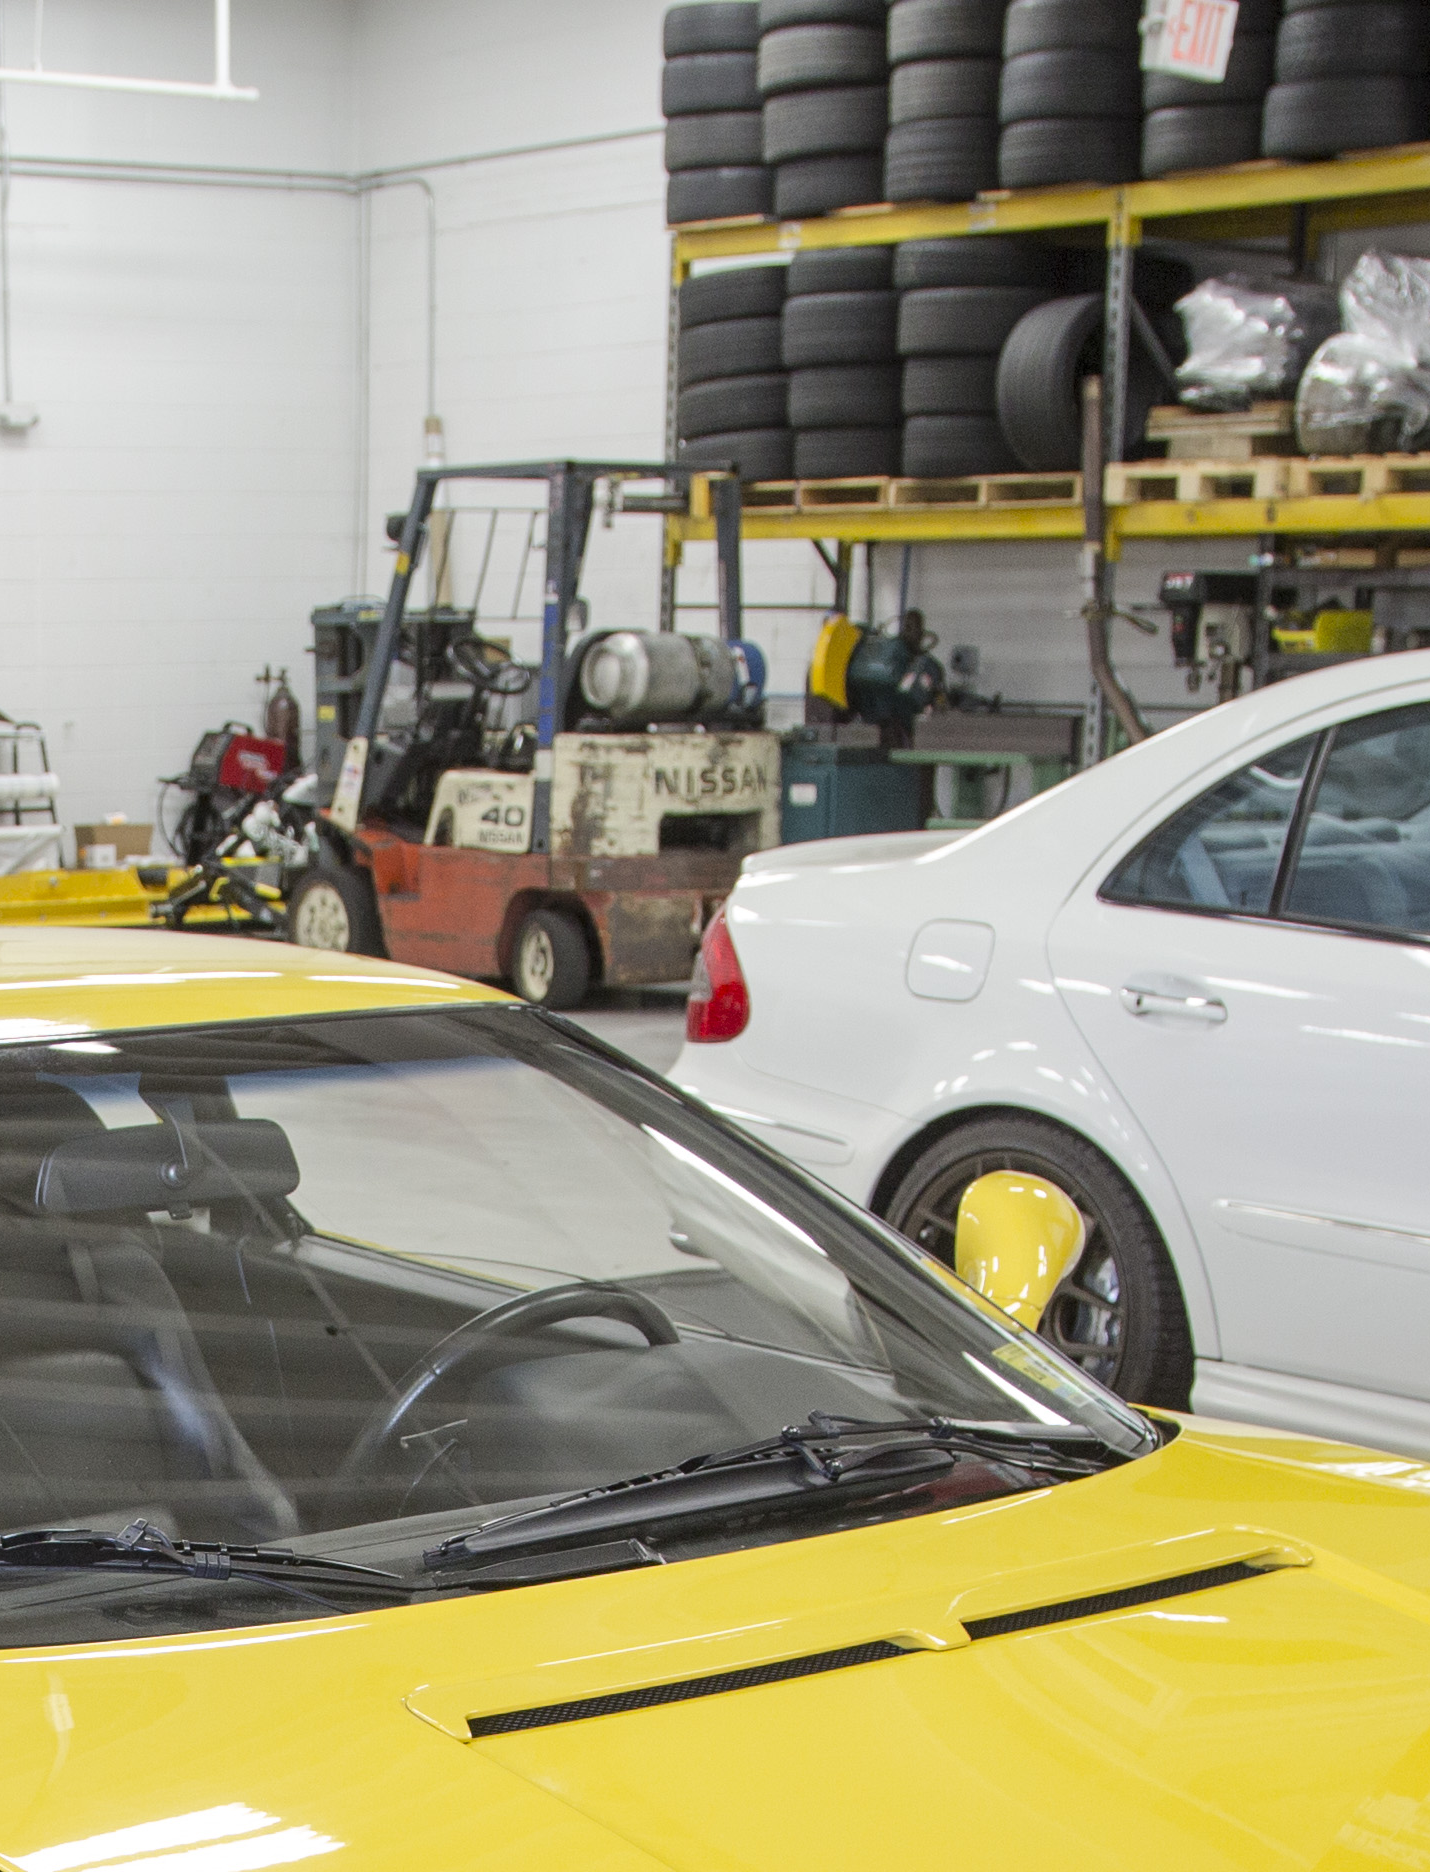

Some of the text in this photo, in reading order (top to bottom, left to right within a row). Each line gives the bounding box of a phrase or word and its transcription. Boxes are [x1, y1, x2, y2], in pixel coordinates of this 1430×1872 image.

[1171, 0, 1228, 67] EXIT
[654, 764, 769, 797] NISSAN
[481, 804, 525, 828] 40
